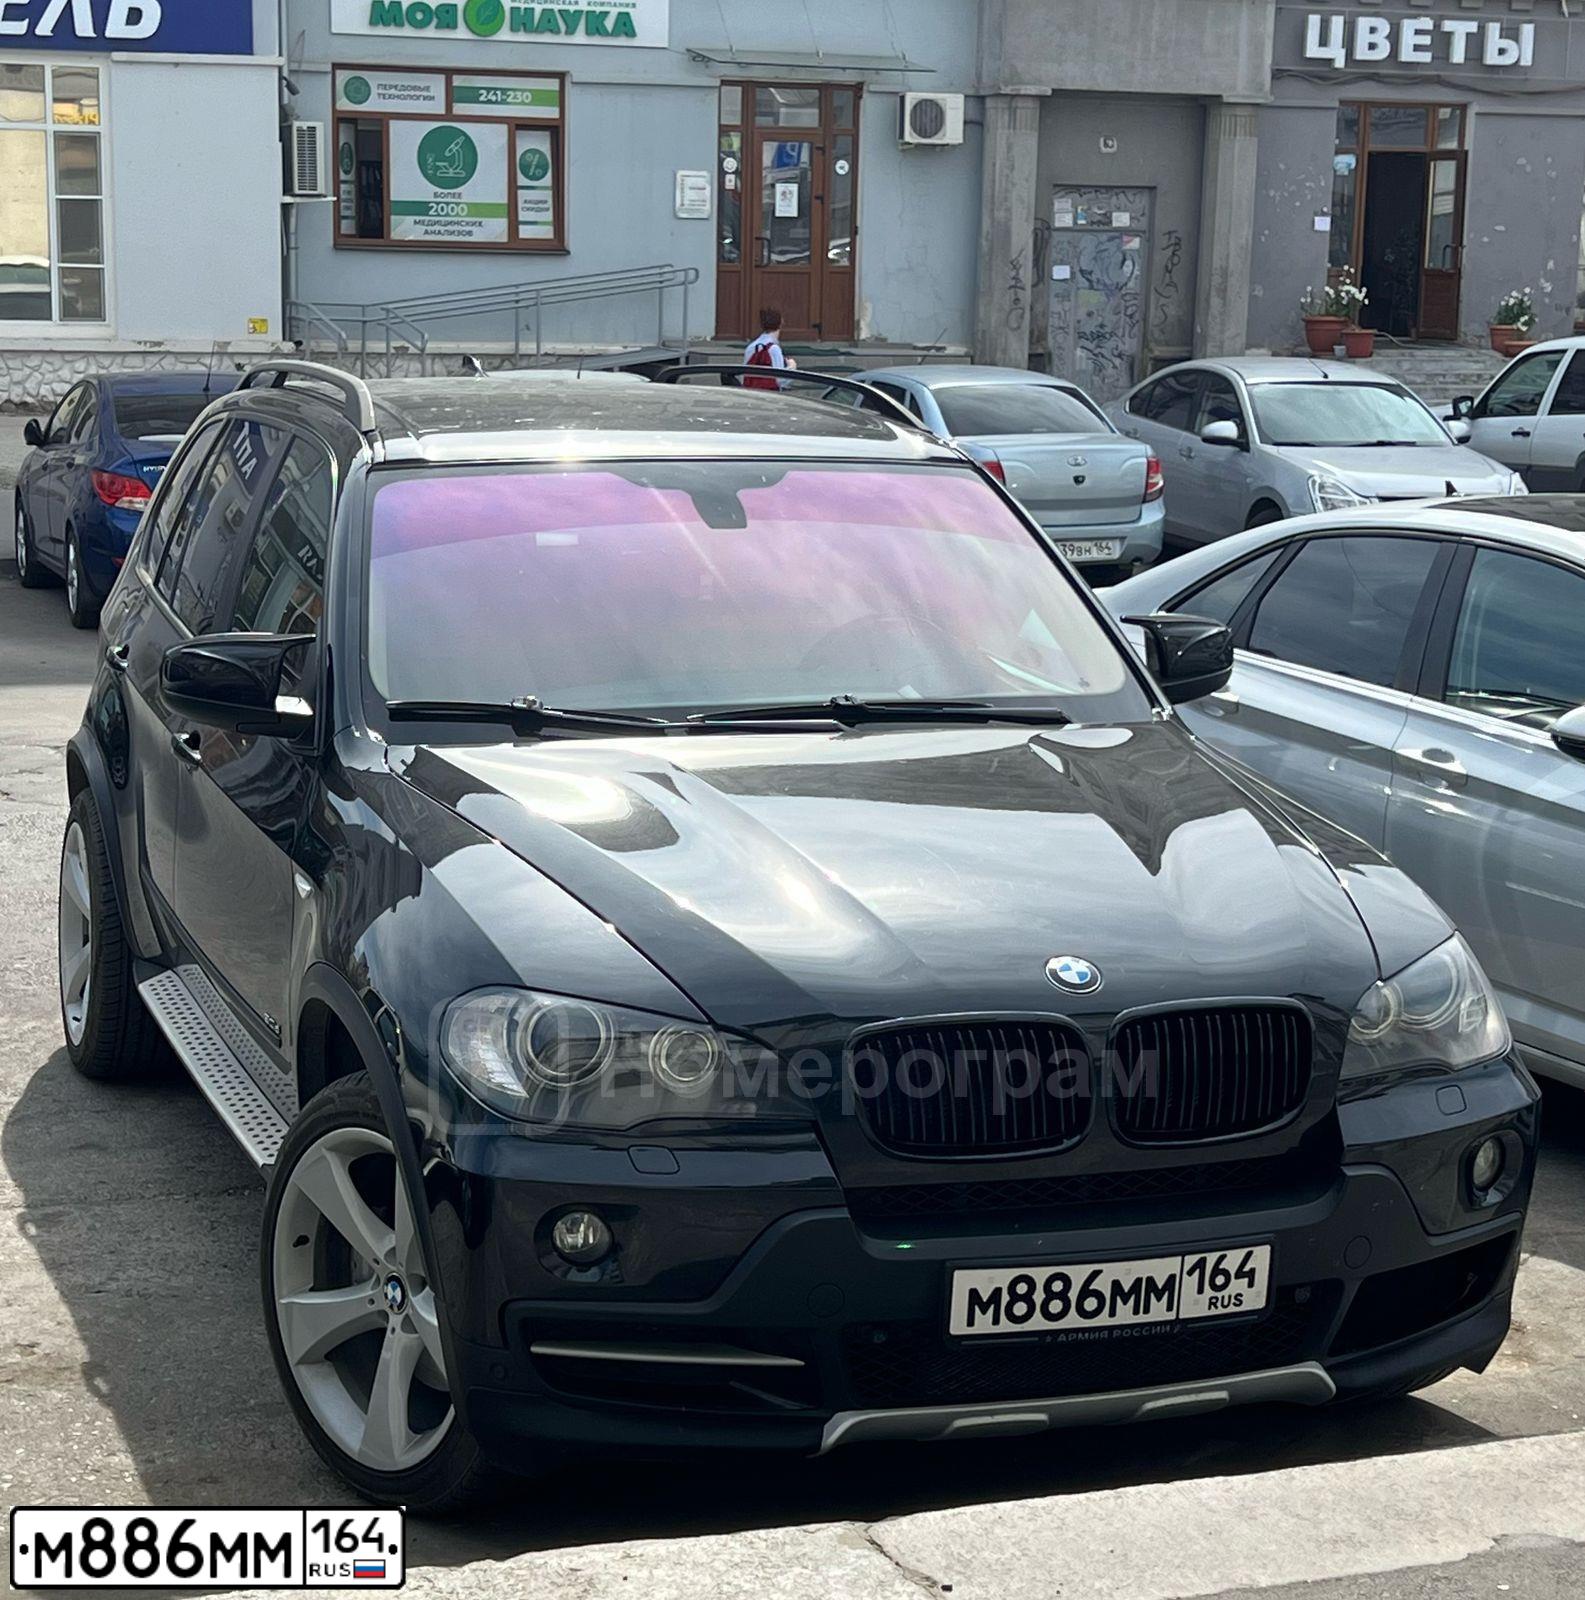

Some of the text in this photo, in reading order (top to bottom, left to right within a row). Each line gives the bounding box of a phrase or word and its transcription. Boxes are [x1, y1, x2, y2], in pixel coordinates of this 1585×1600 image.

[368, 0, 637, 38] МОЯ НАУКА
[1304, 13, 1535, 69] ЦВЕТЫ
[376, 83, 432, 93] ПЕРЕДОВЫЕ
[376, 92, 436, 102] ТЕХНОЛОГИИ
[478, 89, 533, 103] 241-230
[433, 191, 463, 200] БОЛЕЕ
[428, 202, 468, 216] 2000
[422, 228, 475, 238] АНАЛИЗОВ
[966, 1249, 1257, 1328] М886ММ 164
[1207, 1292, 1244, 1312] RUS
[1056, 1324, 1172, 1343] АРМИЯ РОССИИ
